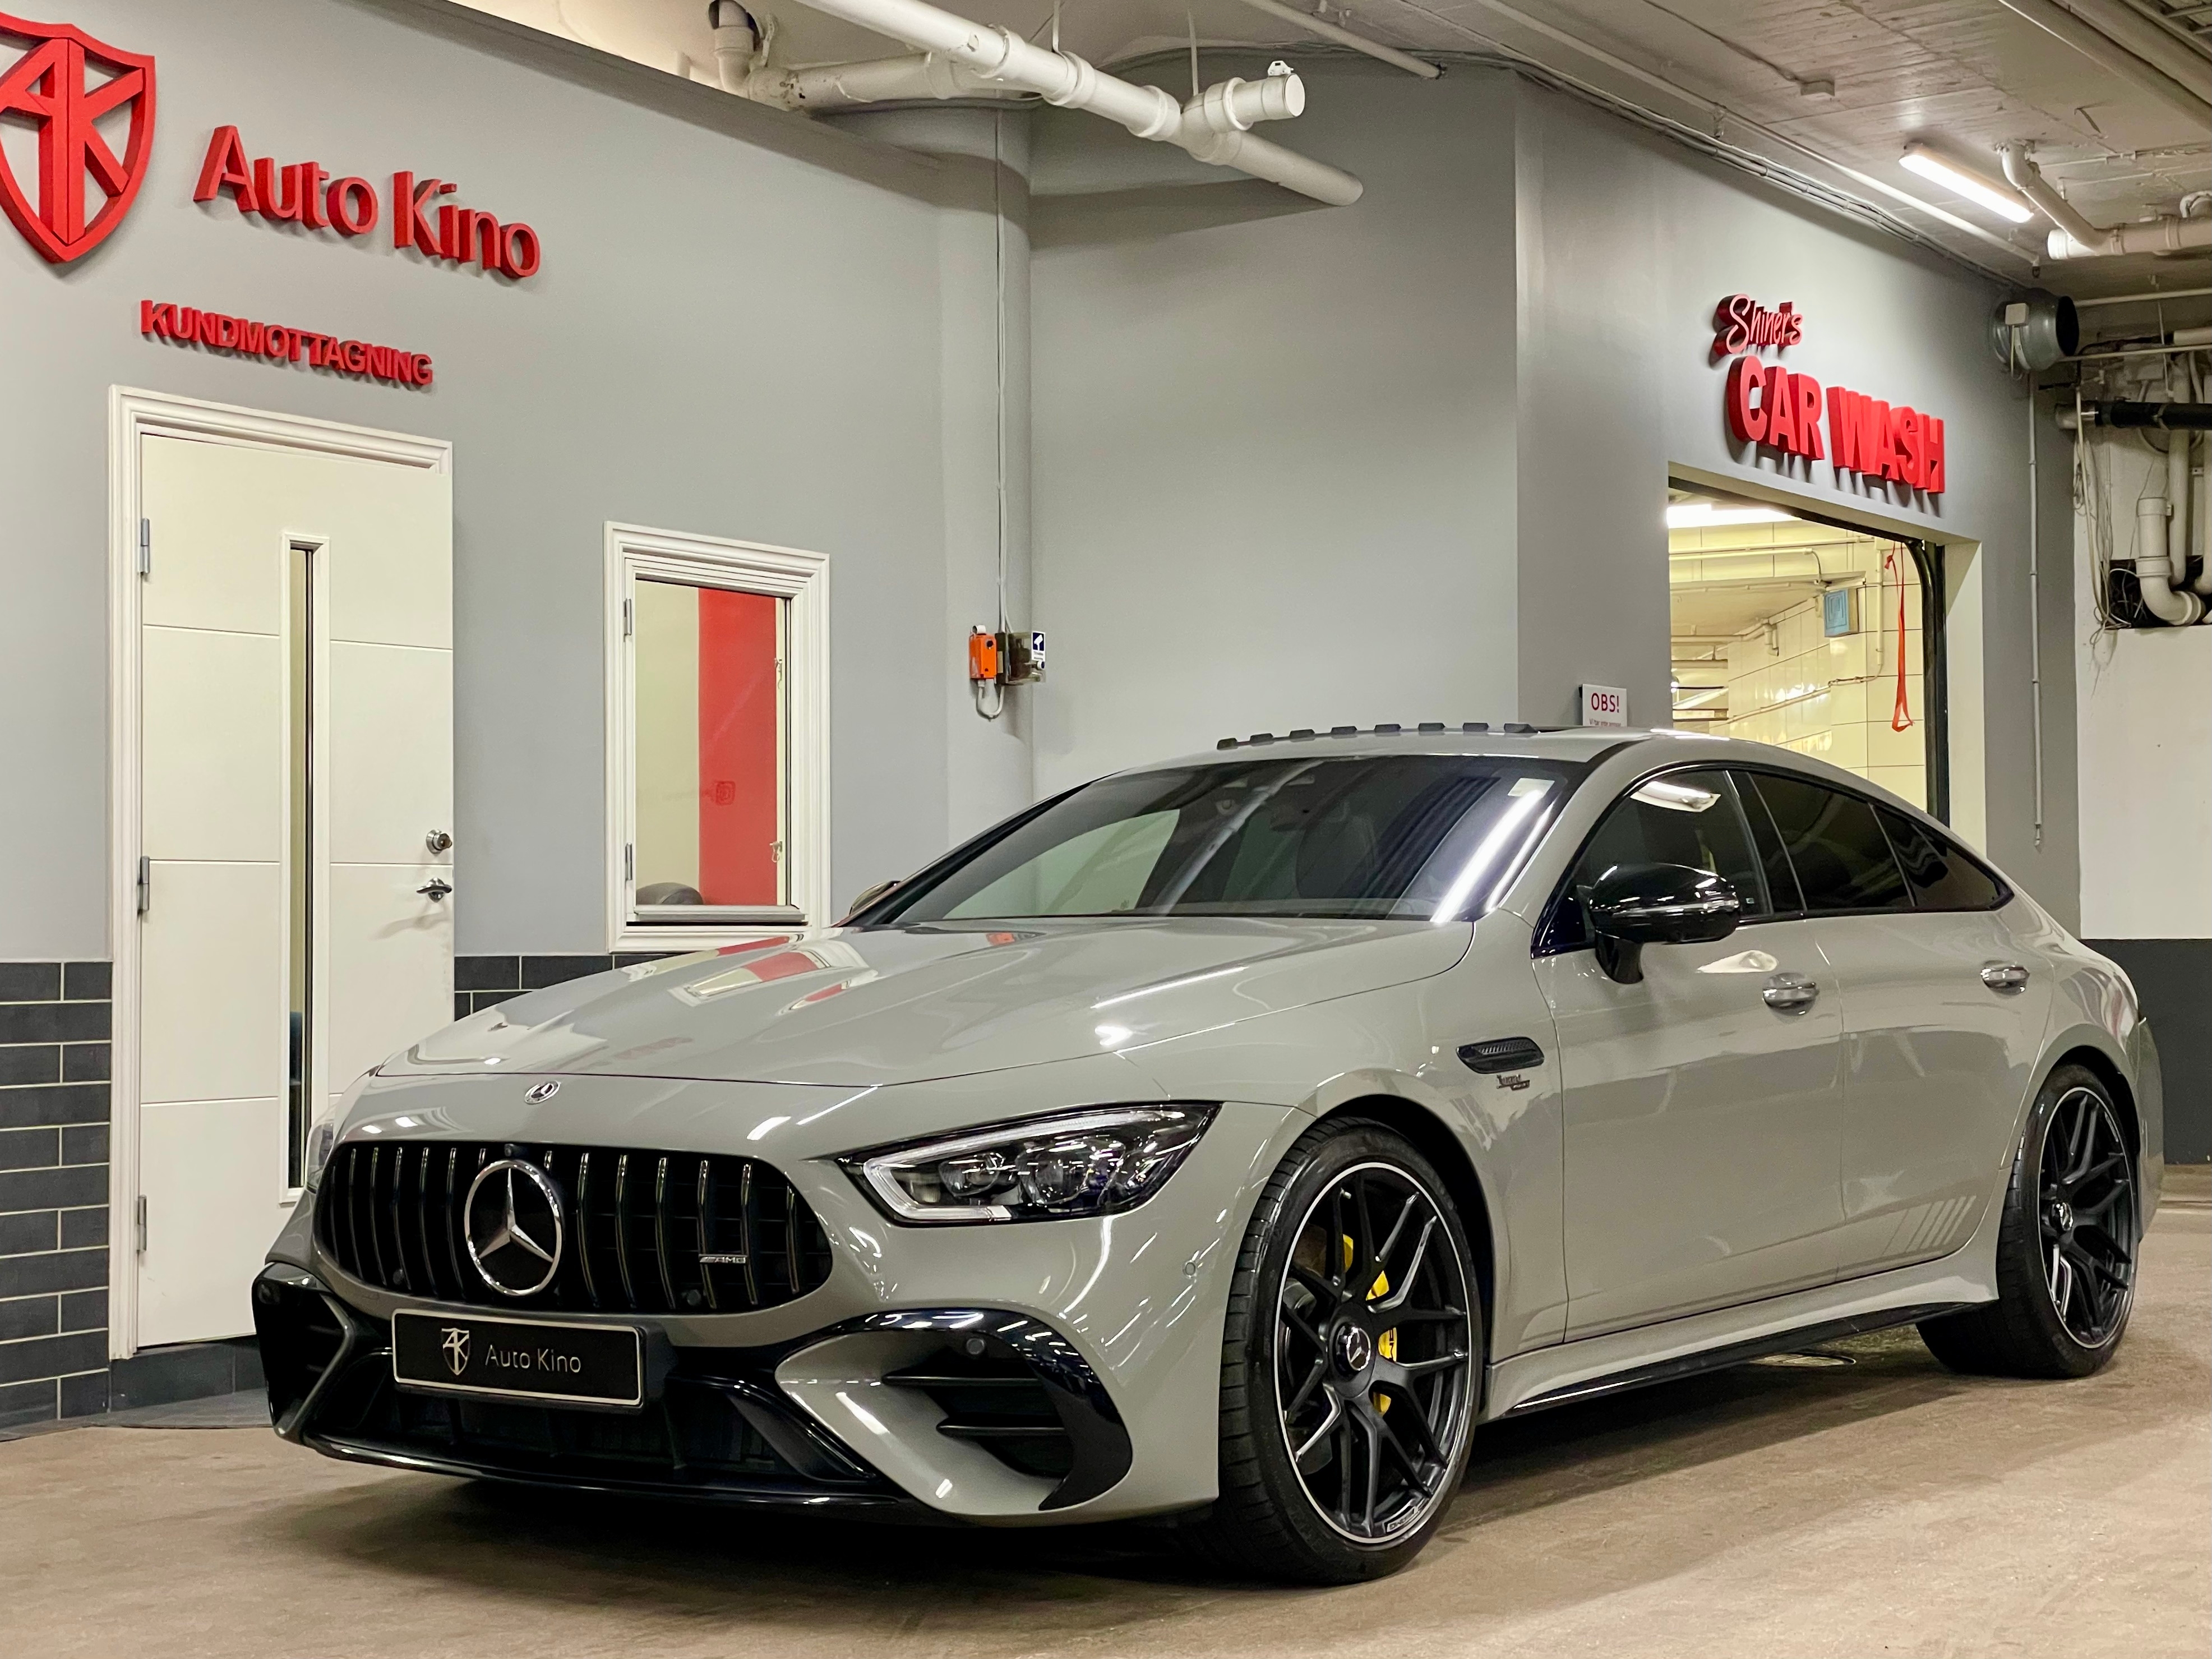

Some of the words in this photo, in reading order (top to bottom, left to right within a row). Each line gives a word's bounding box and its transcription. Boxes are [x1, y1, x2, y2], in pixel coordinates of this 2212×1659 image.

[193, 125, 378, 235] Auto
[393, 170, 541, 279] Kino
[141, 299, 433, 386] KUNDMOTTAGNING
[1727, 355, 1825, 460] CAR
[1826, 386, 1946, 494] WASH
[1591, 692, 1620, 713] OBS!
[484, 1344, 531, 1369] Auto
[537, 1347, 581, 1374] Kino
